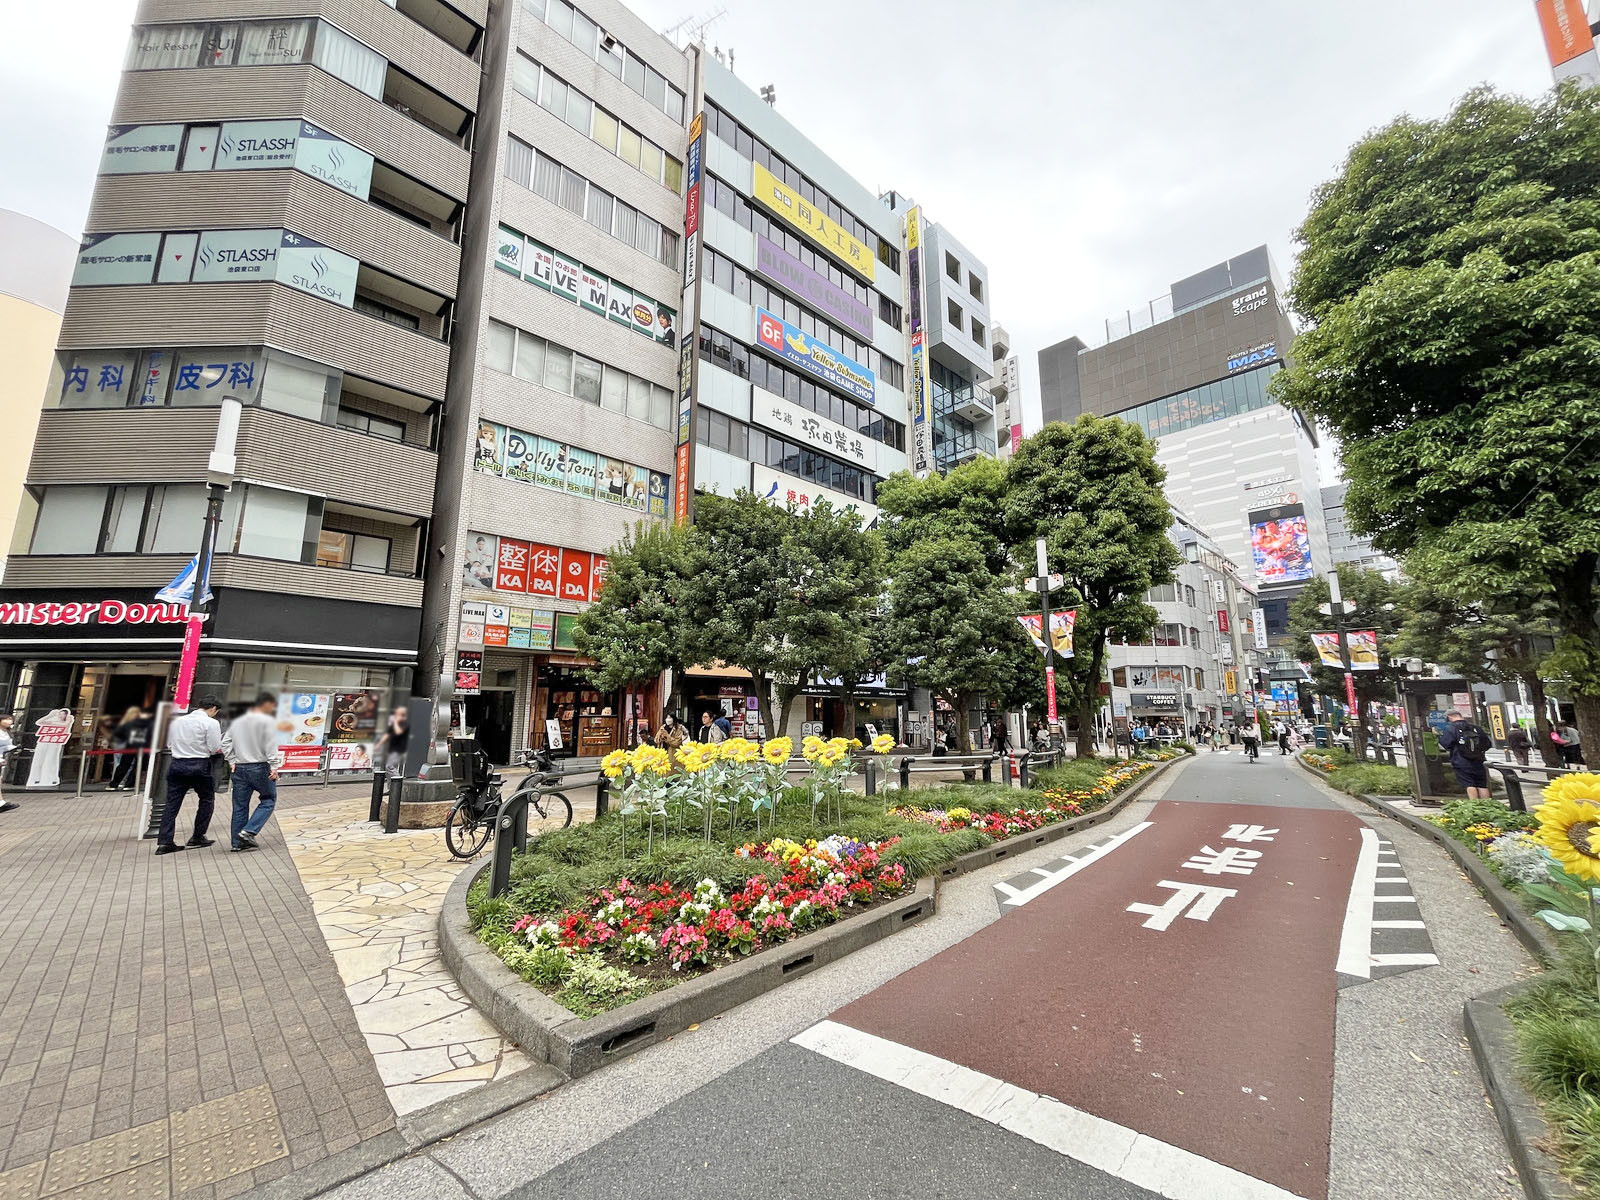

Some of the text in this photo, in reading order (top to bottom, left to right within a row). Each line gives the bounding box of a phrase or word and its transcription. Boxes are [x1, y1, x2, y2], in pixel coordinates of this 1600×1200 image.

[137, 38, 236, 52] Hair Resort SUI
[283, 49, 301, 57] SUI
[303, 124, 319, 136] 5F
[238, 137, 296, 152] STLASSH
[310, 164, 358, 193] STLASSH
[284, 233, 301, 246] 4F
[798, 202, 861, 262] 同人工房
[80, 254, 152, 264] 脱毛サロンの新常識
[216, 248, 277, 263] STLASSH
[291, 274, 342, 300] STLASSH
[1232, 286, 1267, 309] grand
[589, 288, 633, 320] MAX
[1233, 297, 1268, 317] scape
[762, 320, 782, 343] 6F
[912, 335, 921, 345] 6F
[811, 348, 836, 370] Yellow
[1227, 347, 1276, 370] IMAX
[63, 364, 124, 393] 内科
[175, 361, 255, 391] 皮フ科
[856, 387, 873, 400] SHOP
[503, 434, 557, 471] Dolly
[786, 489, 809, 507] 焼肉
[500, 543, 558, 575] 整体
[0, 600, 209, 624] mister Donu
[463, 608, 474, 616] LIVE
